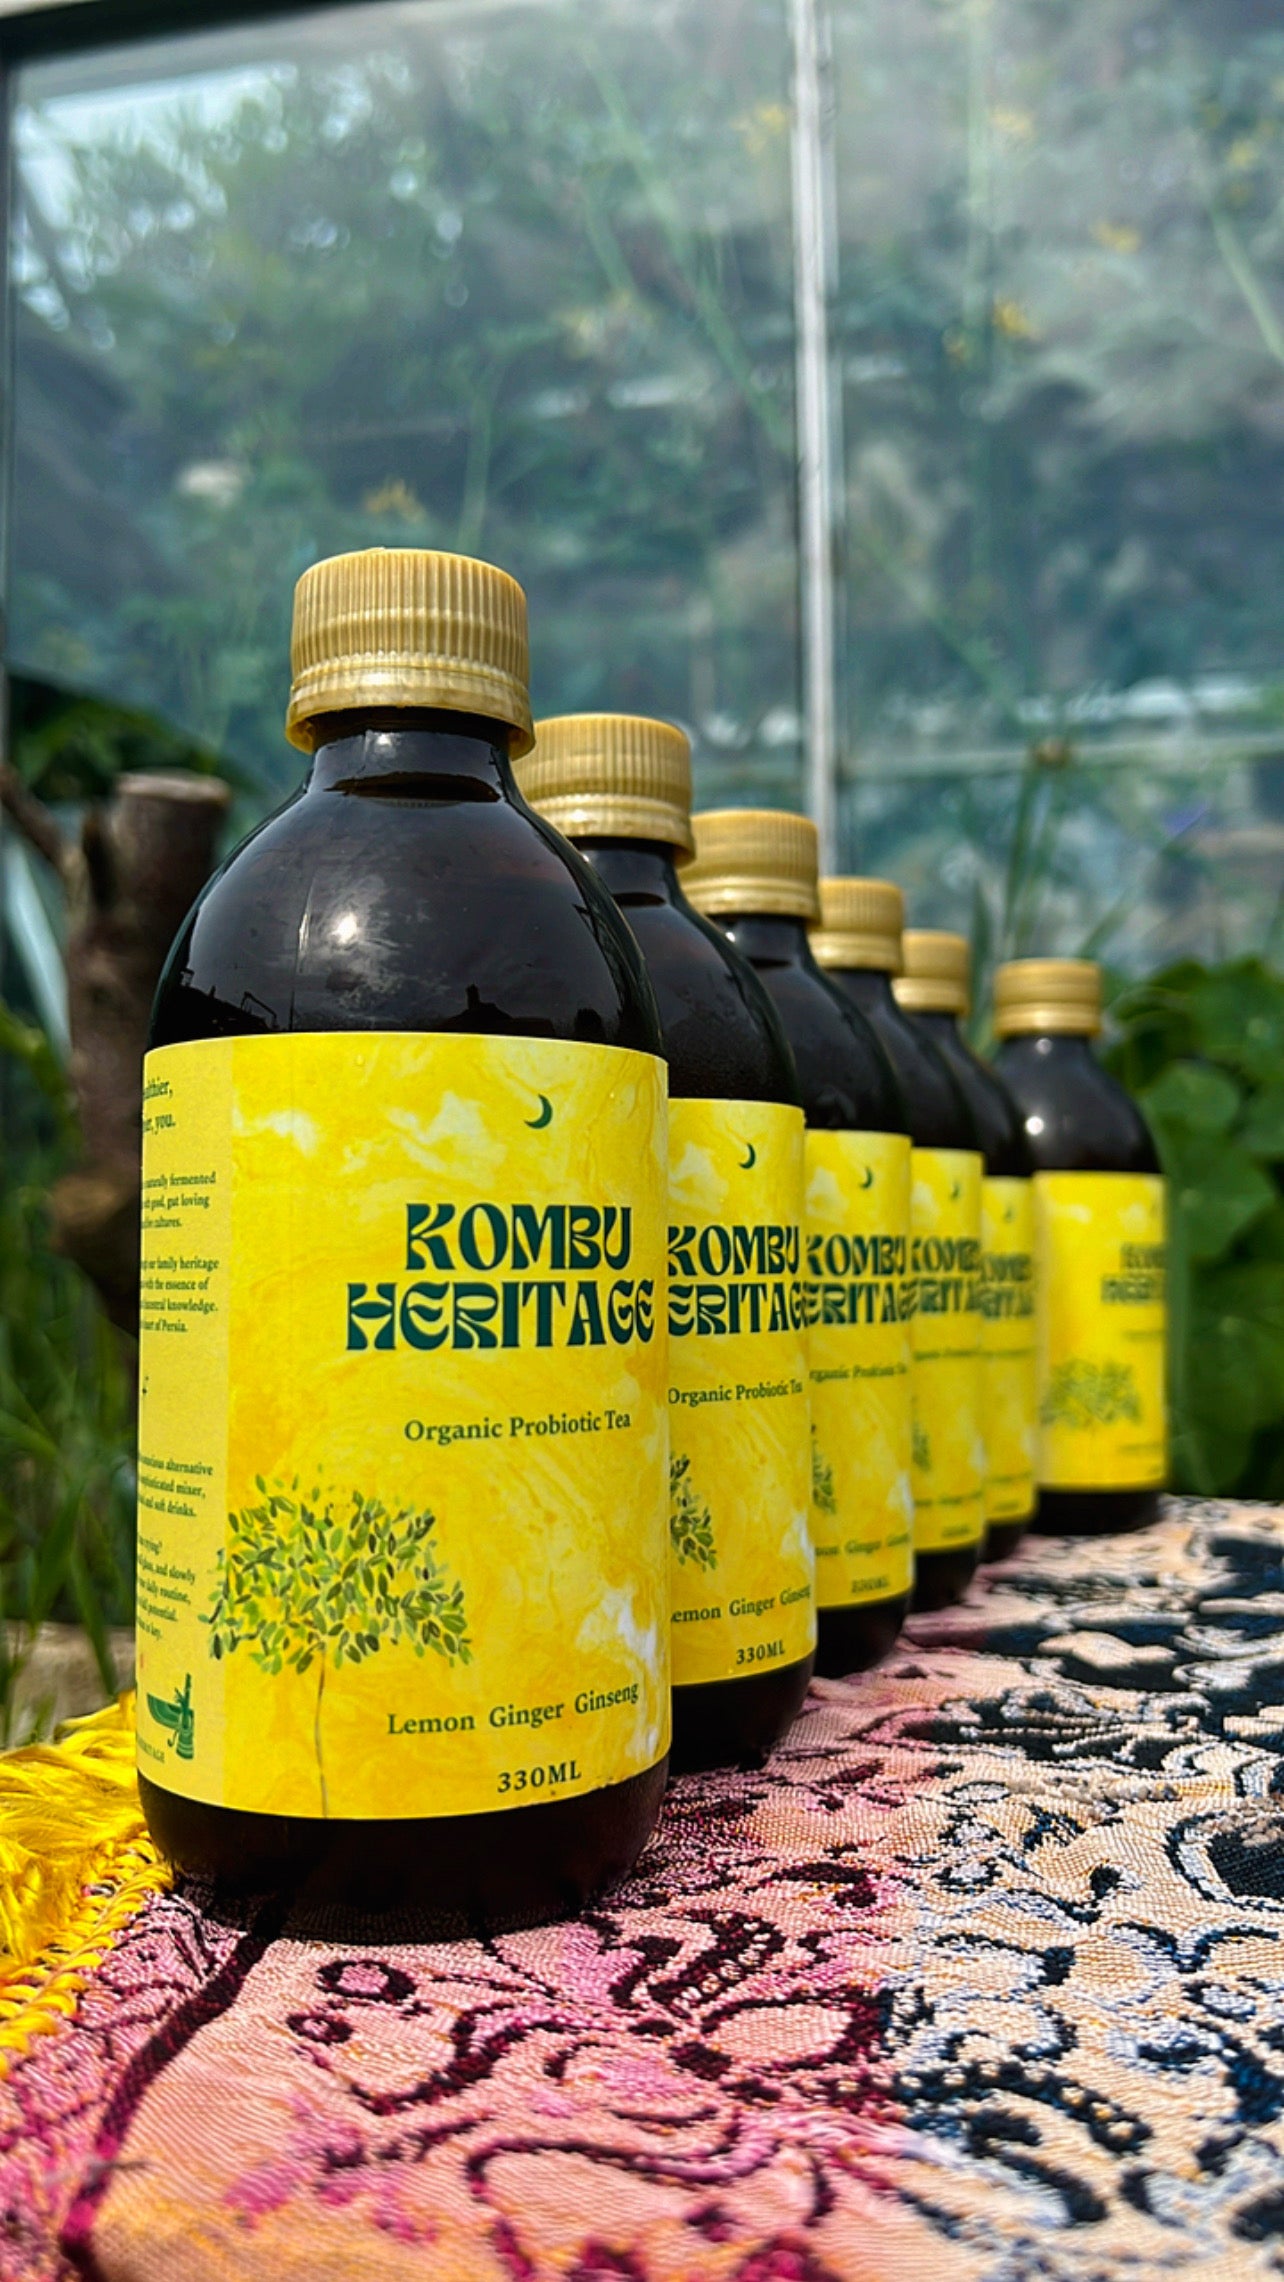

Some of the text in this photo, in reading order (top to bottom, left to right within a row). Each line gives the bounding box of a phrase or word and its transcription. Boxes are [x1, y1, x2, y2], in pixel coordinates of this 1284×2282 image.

[169, 1171, 217, 1186] fermented
[181, 1193, 210, 1209] loving
[405, 1203, 633, 1272] KOMBU
[667, 1224, 800, 1277] KOMBU
[180, 1256, 220, 1272] heritage
[198, 1276, 210, 1290] of
[167, 1298, 218, 1315] knowledge.
[346, 1279, 656, 1352] HERITAGE
[667, 1281, 806, 1337] ERITAG
[667, 1384, 732, 1408] Organic
[736, 1379, 789, 1401] Probiotic
[403, 1409, 632, 1446] Organic Probiotic Tea
[166, 1457, 214, 1476] alternative
[176, 1480, 206, 1499] mixer,
[167, 1500, 198, 1517] drinks.
[169, 1564, 196, 1585] slowly
[671, 1605, 722, 1623] emon
[728, 1596, 776, 1617] Ginger
[735, 1639, 786, 1665] 330ML
[387, 1682, 640, 1736] Lemon Ginger Ginseng
[496, 1759, 582, 1794] 330ML
